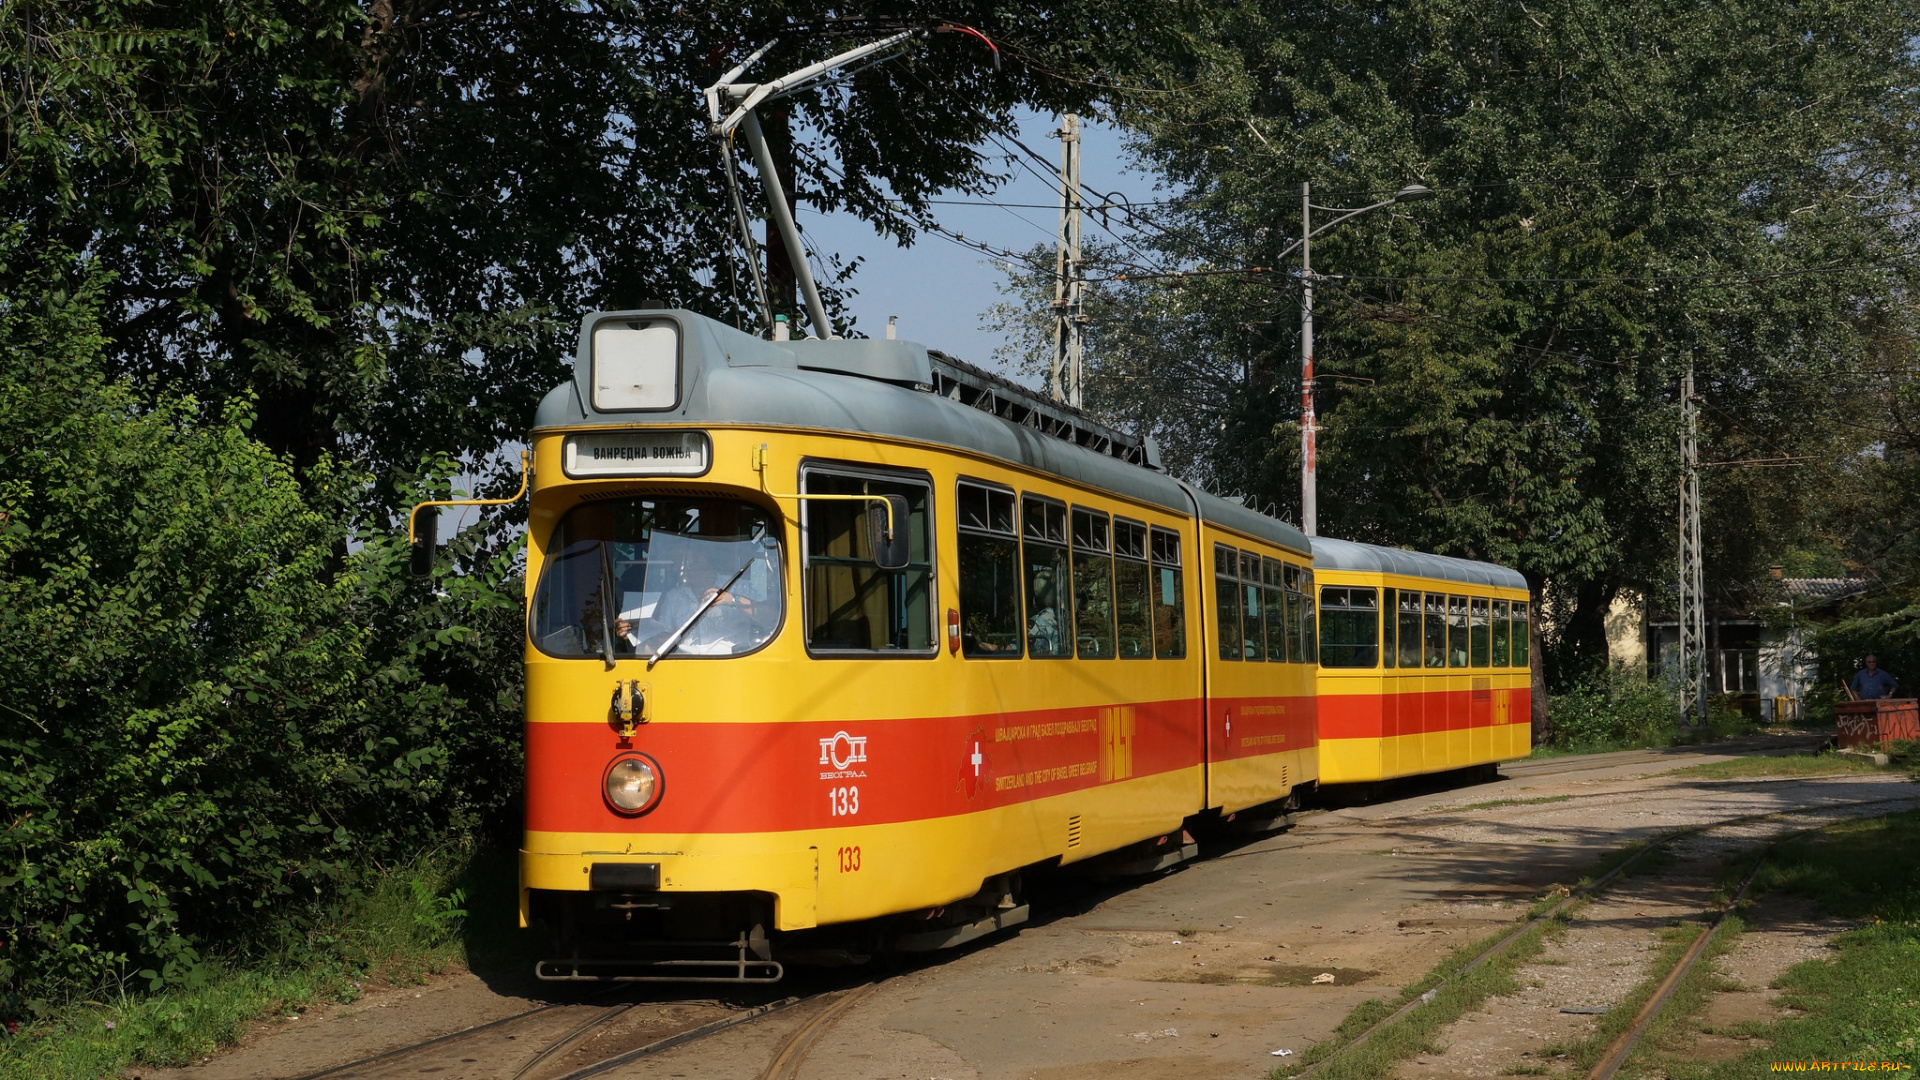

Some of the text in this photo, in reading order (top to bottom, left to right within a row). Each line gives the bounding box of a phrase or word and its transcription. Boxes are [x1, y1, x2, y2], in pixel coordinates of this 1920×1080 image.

[593, 446, 691, 461] ВАНРЕДНА ВОЖЊА
[819, 730, 867, 770] ГСП
[995, 774, 1025, 791] SWITZERLAND
[1025, 772, 1034, 785] AND
[1034, 770, 1042, 784] THE
[1051, 768, 1056, 780] OF
[1056, 767, 1068, 779] BASEL
[829, 785, 859, 816] 133
[838, 846, 861, 873] 133
